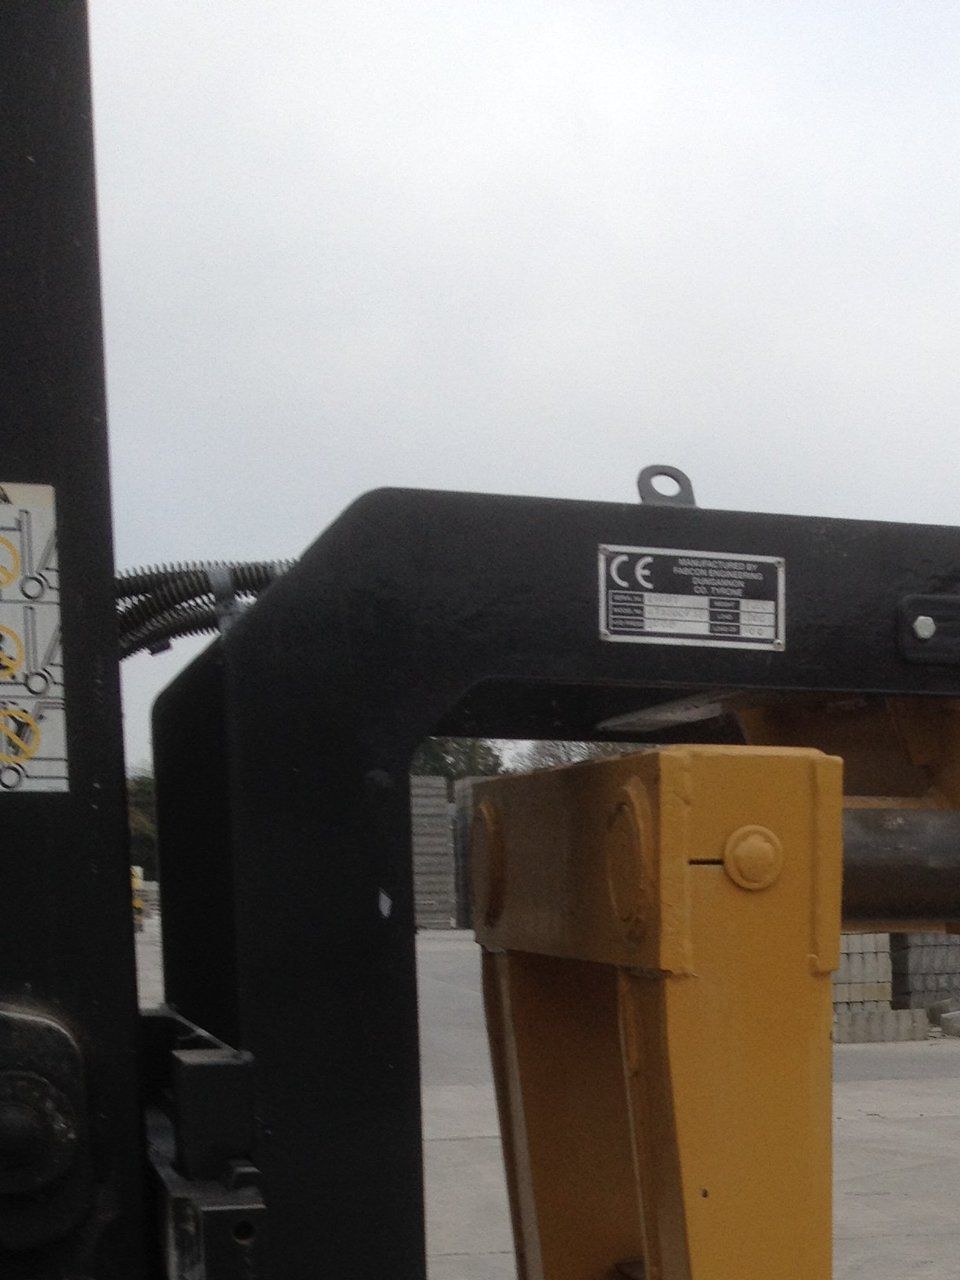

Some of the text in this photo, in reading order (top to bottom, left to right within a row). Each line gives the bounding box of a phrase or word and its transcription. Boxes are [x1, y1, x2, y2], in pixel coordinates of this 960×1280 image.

[678, 558, 758, 571] MANUFACTURED BY
[610, 554, 654, 588] CE
[708, 569, 764, 581] ENGINEERING
[710, 586, 743, 597] TYRONE
